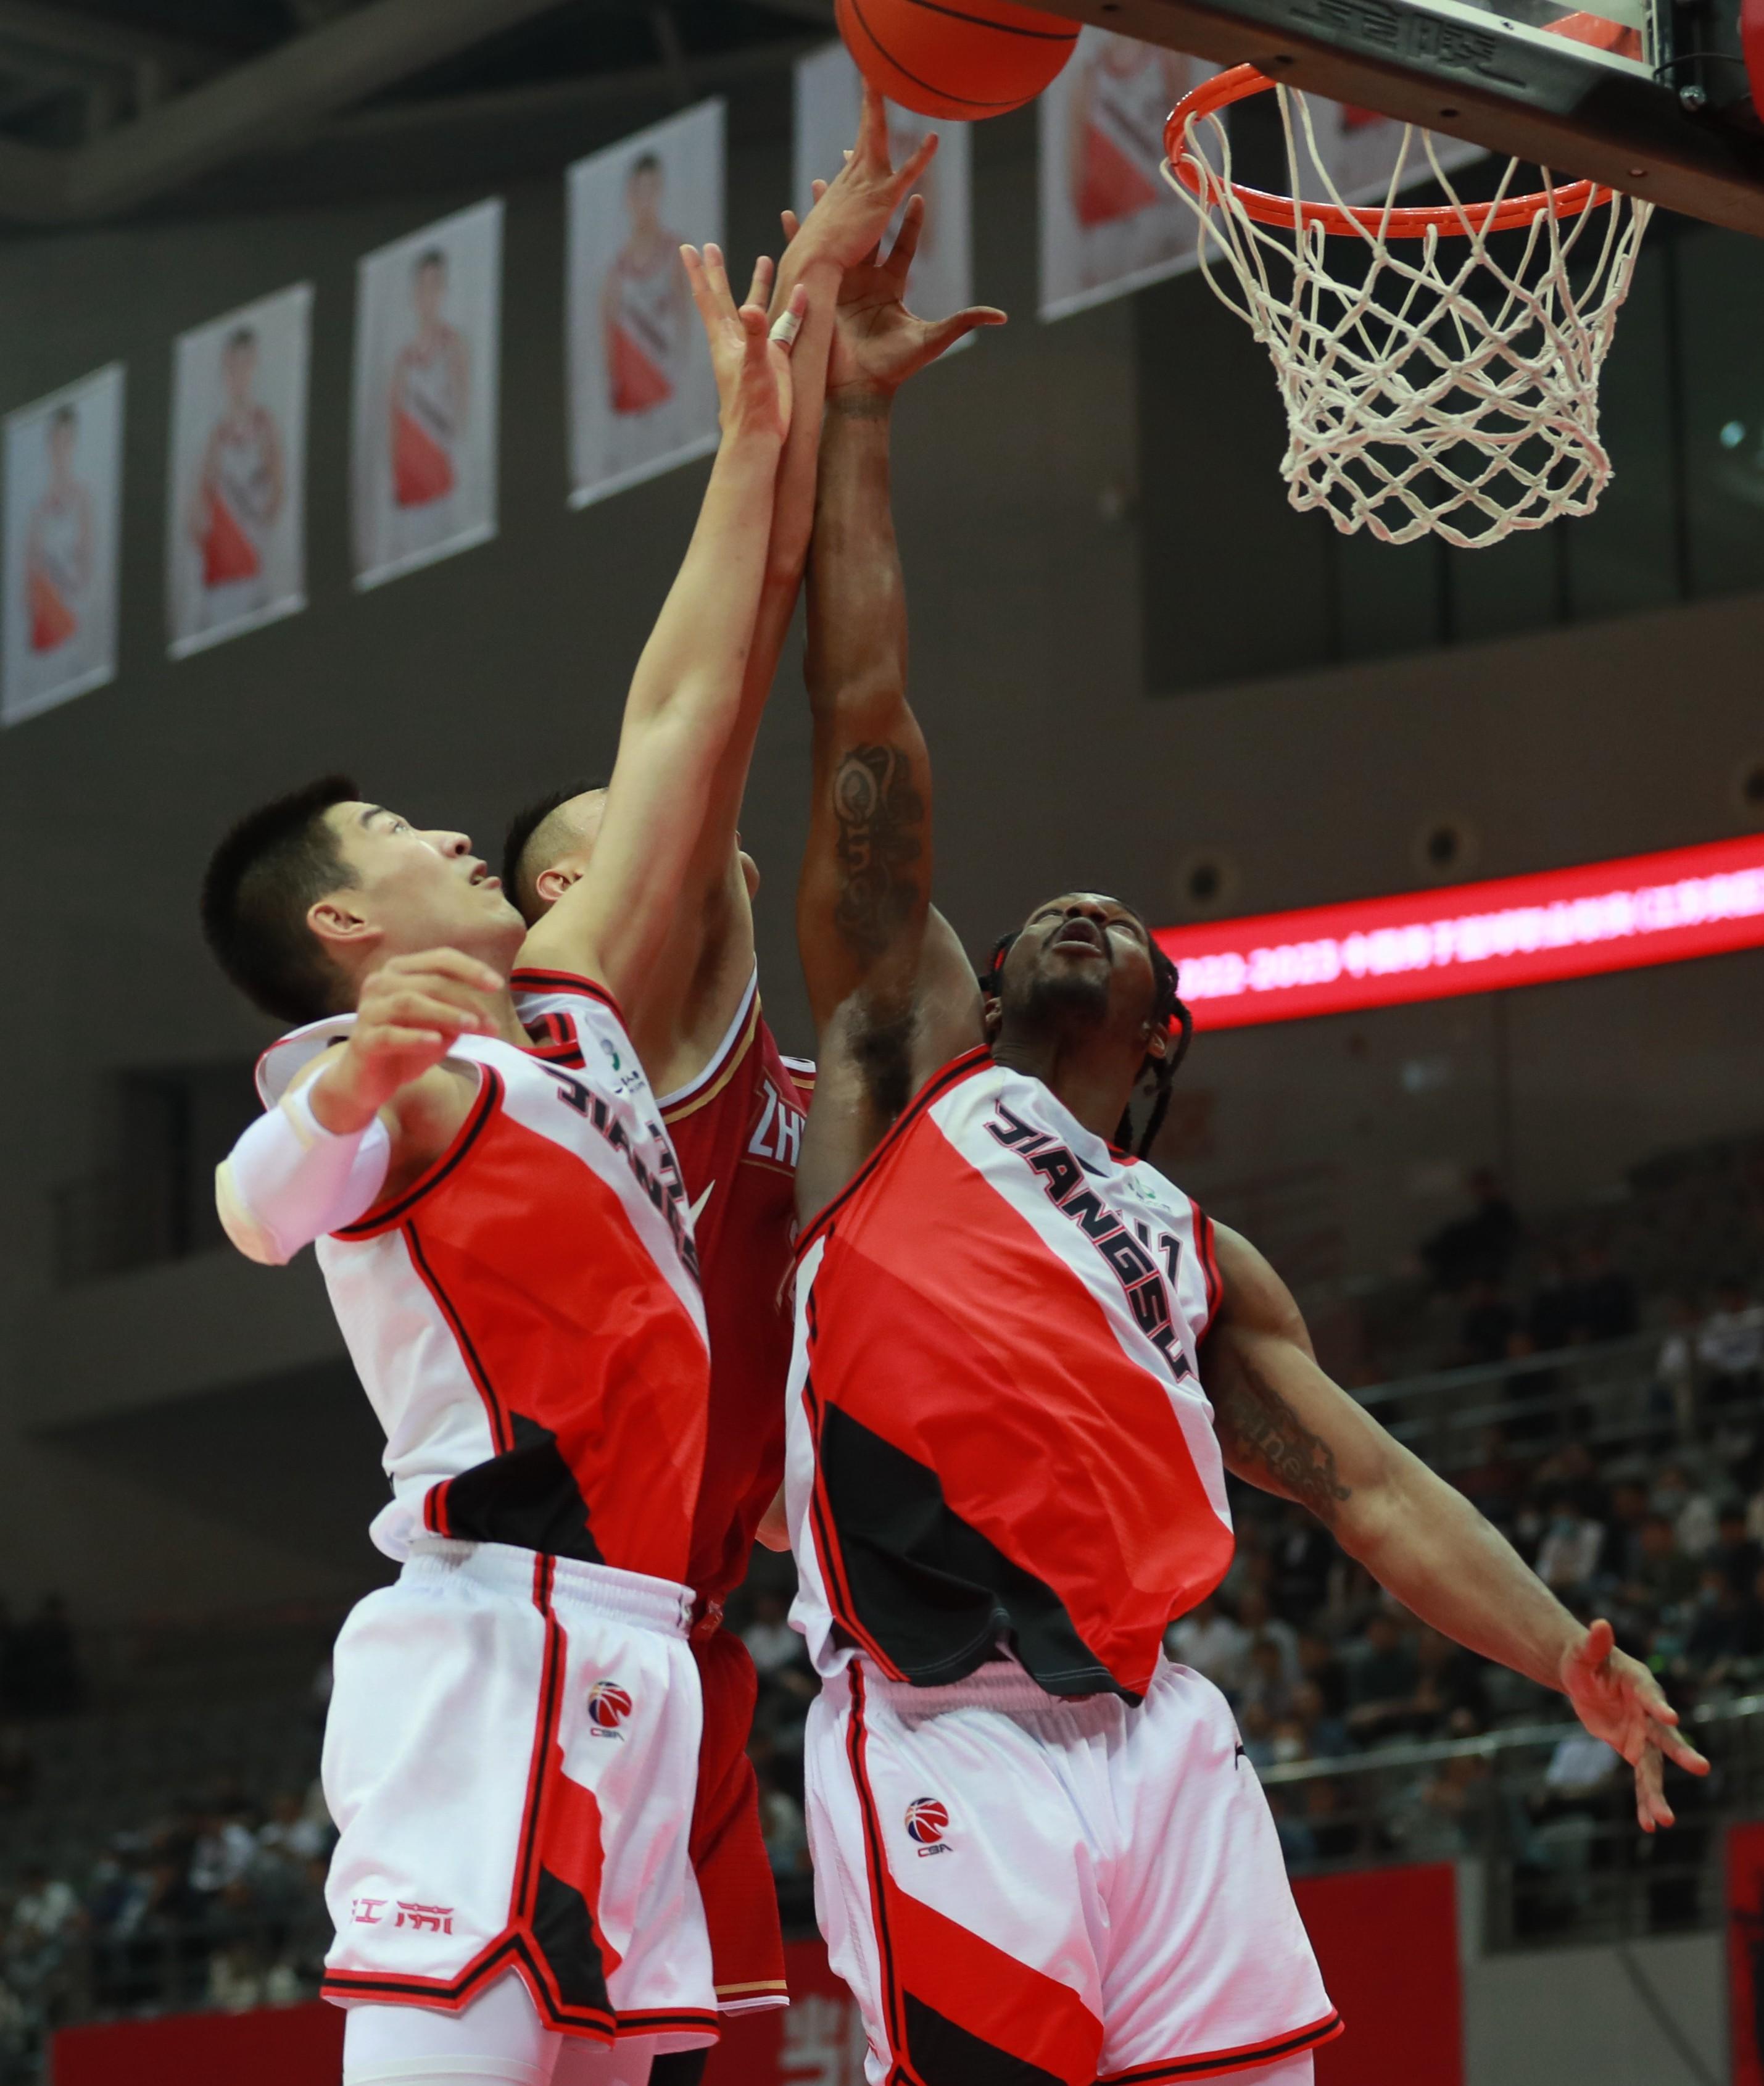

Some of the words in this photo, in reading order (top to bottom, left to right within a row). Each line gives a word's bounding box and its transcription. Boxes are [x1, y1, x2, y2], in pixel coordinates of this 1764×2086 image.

[748, 1079, 805, 1167] ZH
[983, 1099, 1199, 1384] JIANGSU
[917, 1843, 953, 1857] CBA
